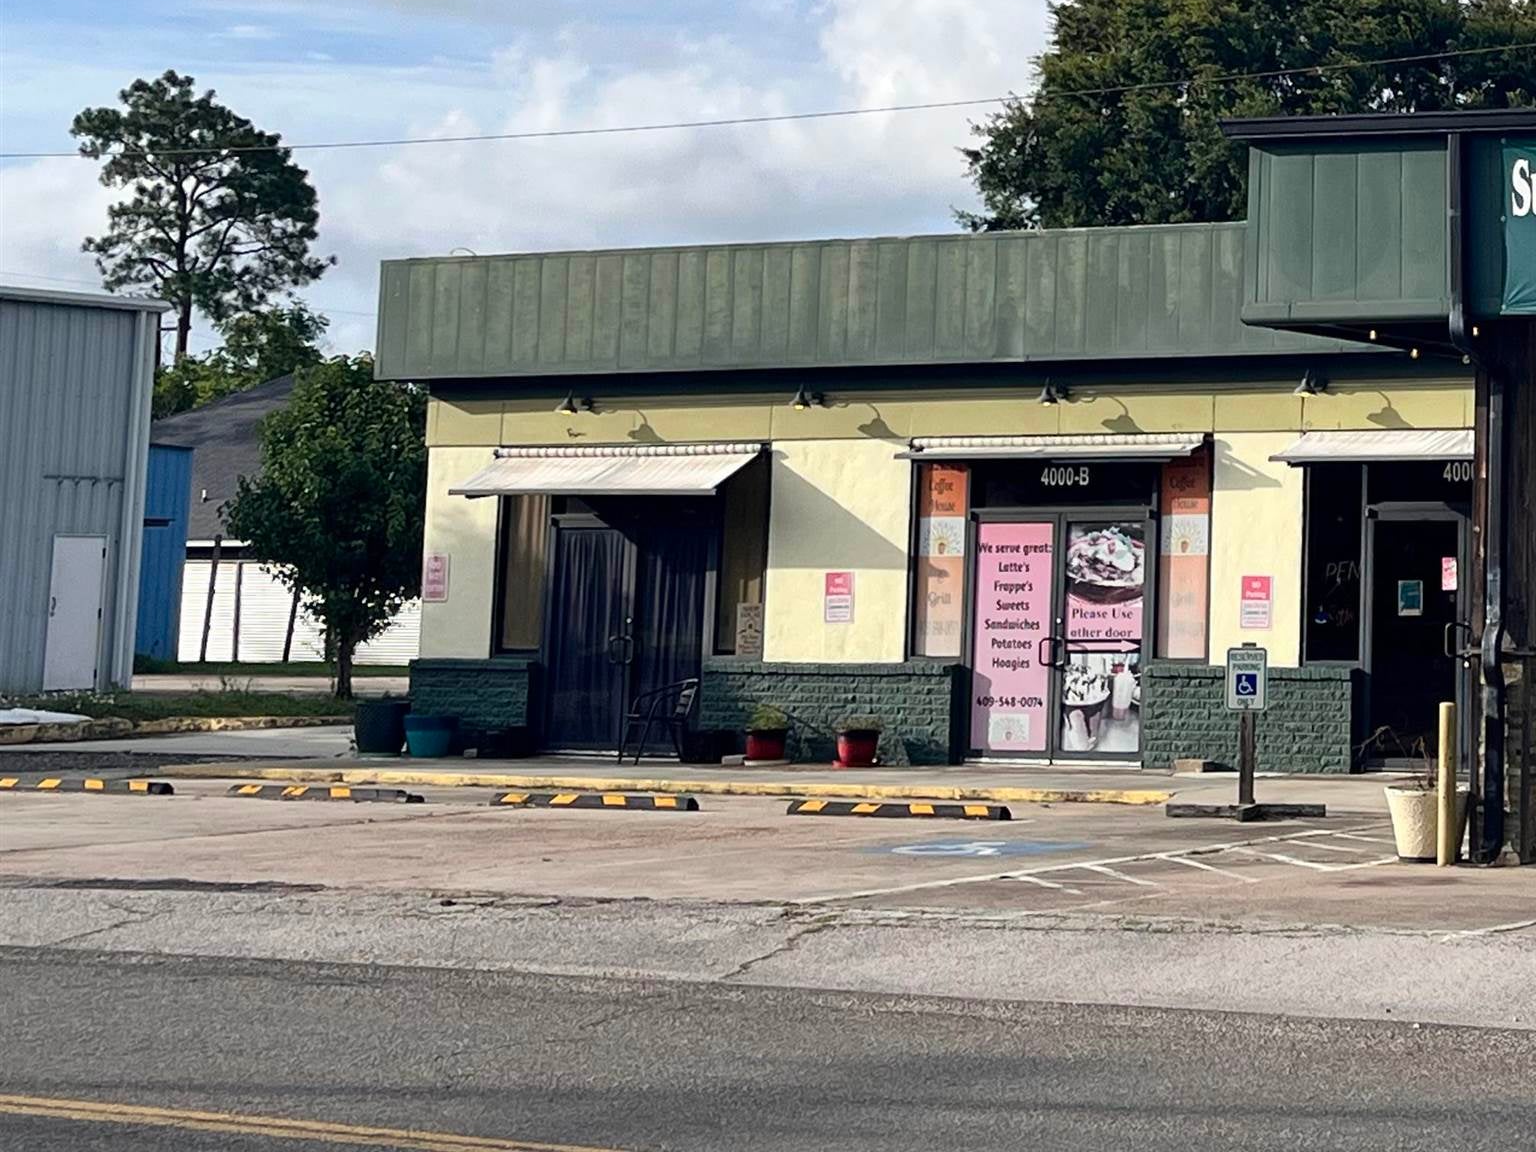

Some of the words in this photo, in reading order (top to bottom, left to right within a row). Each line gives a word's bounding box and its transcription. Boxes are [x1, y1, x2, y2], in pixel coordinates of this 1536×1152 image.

[1041, 467, 1089, 486] 4000-B
[978, 542, 993, 554] We
[995, 544, 1021, 554] serve
[998, 561, 1030, 573] Latte's
[994, 580, 1034, 594] Frappe's
[996, 599, 1030, 611] Sweets
[1072, 608, 1108, 619] Please
[1112, 608, 1134, 619] Use
[984, 617, 1041, 630] Sandwiches
[1070, 628, 1102, 638] other
[1105, 627, 1134, 638] door
[991, 637, 1033, 649] Potatoes
[992, 657, 1030, 671] Hoagies
[976, 695, 1044, 707] 409-548-0074
